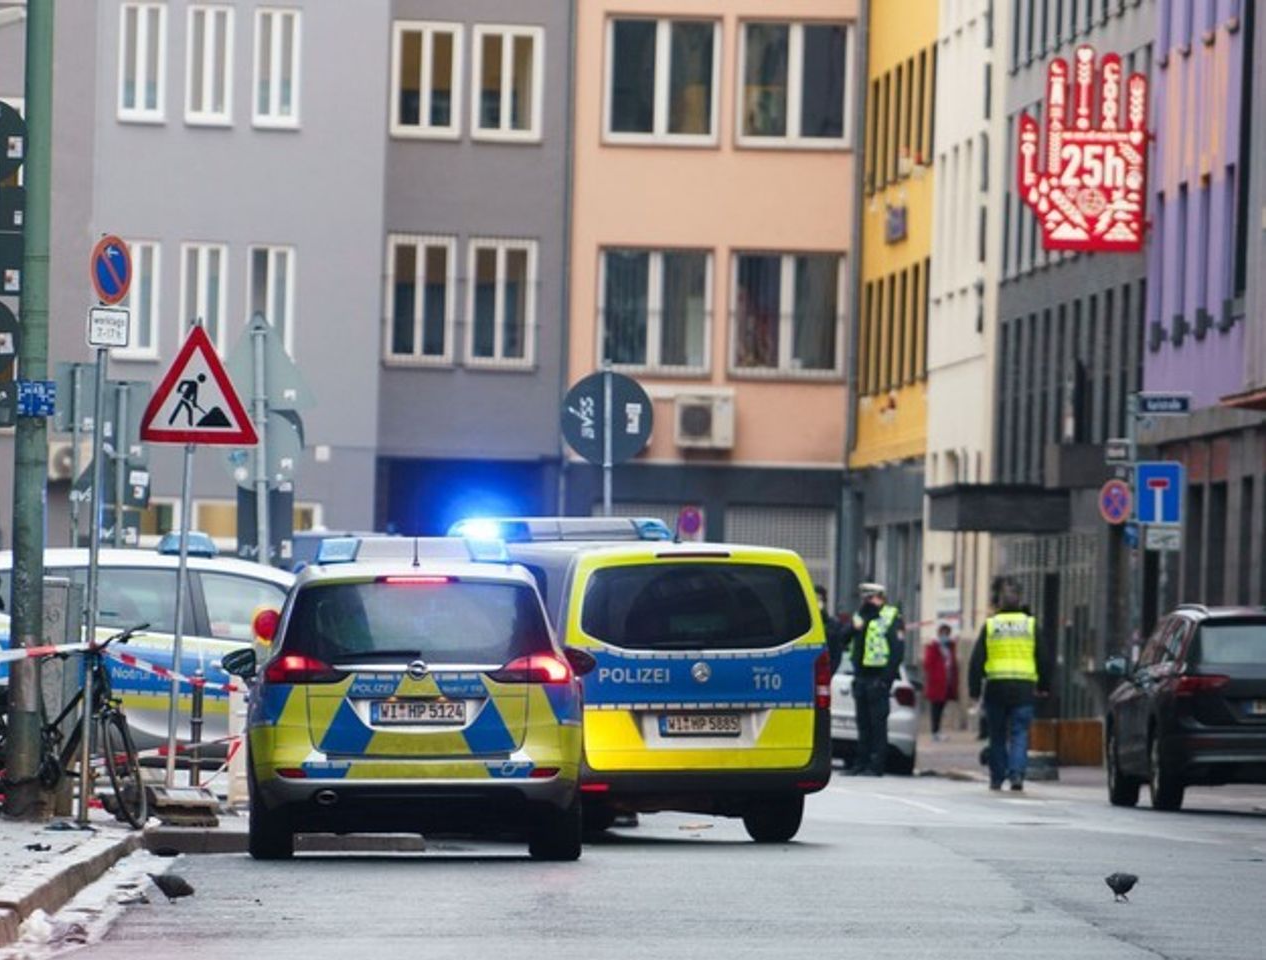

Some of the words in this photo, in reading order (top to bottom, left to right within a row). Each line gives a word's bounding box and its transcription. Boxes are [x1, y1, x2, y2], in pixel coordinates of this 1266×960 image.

[1060, 143, 1126, 188] 25h
[598, 667, 670, 683] POLIZEI
[753, 673, 782, 690] 110
[351, 683, 395, 694] POLIZEI
[429, 704, 463, 719] 5124
